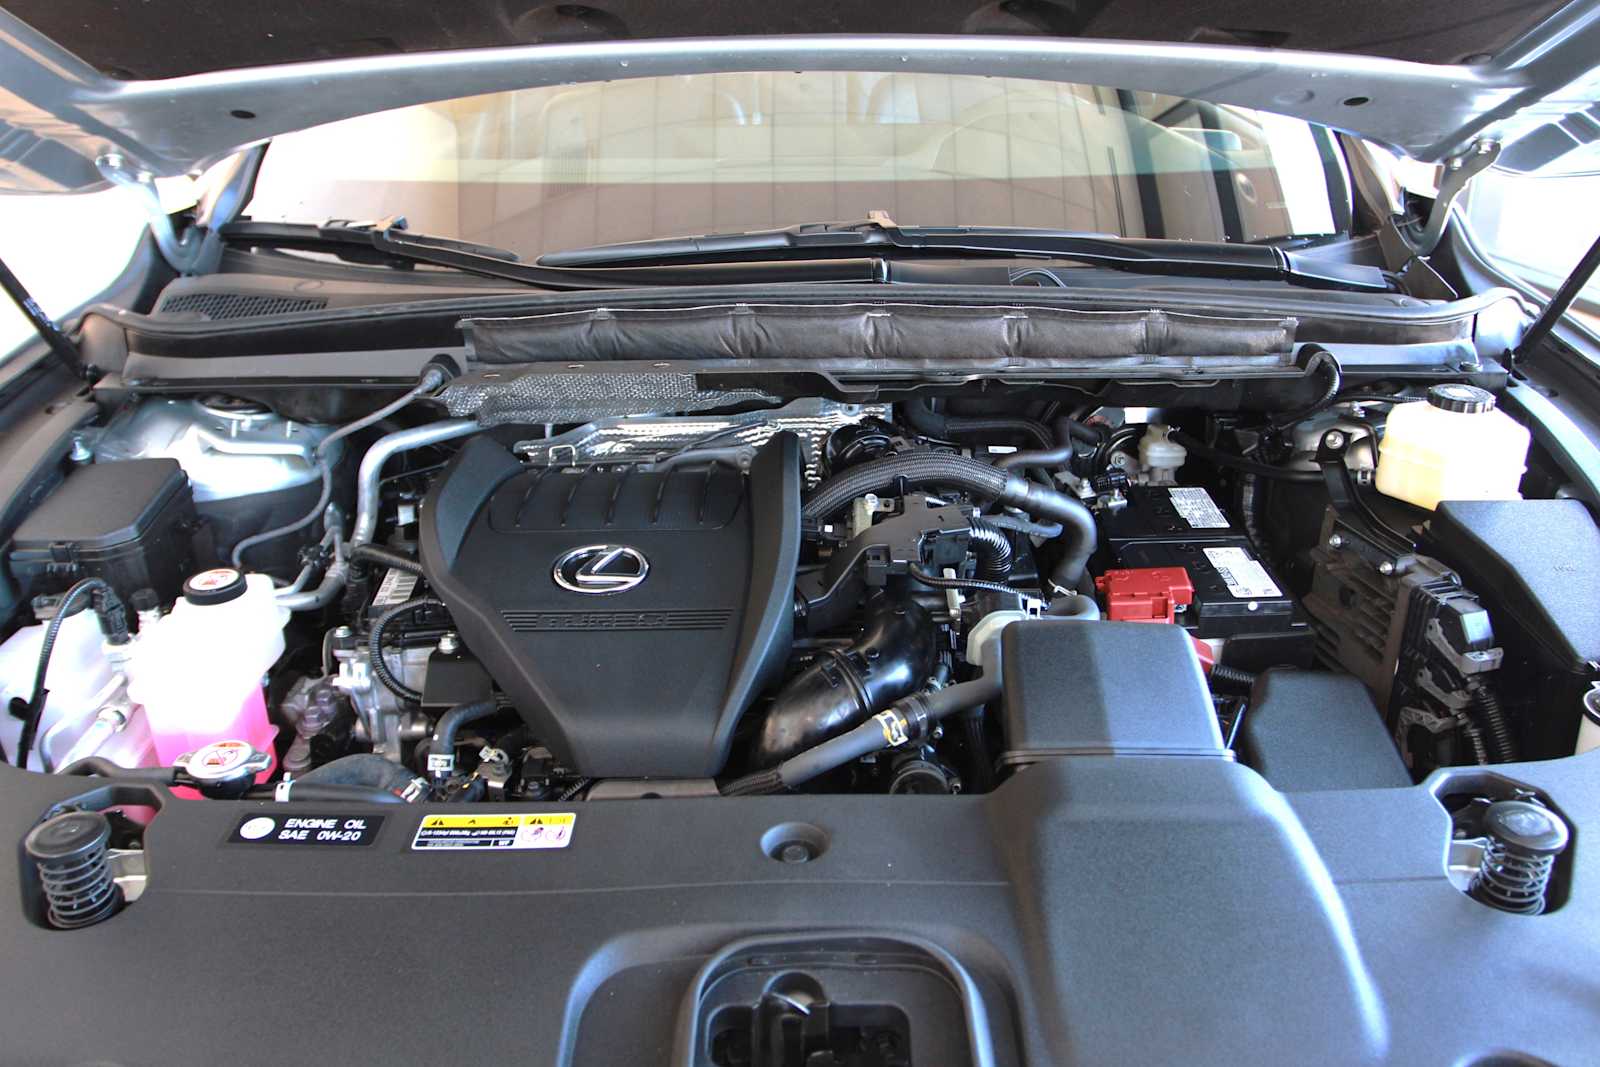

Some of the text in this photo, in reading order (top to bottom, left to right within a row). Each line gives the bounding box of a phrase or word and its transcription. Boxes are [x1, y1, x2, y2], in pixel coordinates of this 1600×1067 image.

[284, 818, 367, 830] ENGINE OIL
[278, 830, 362, 841] SAE 0W-20
